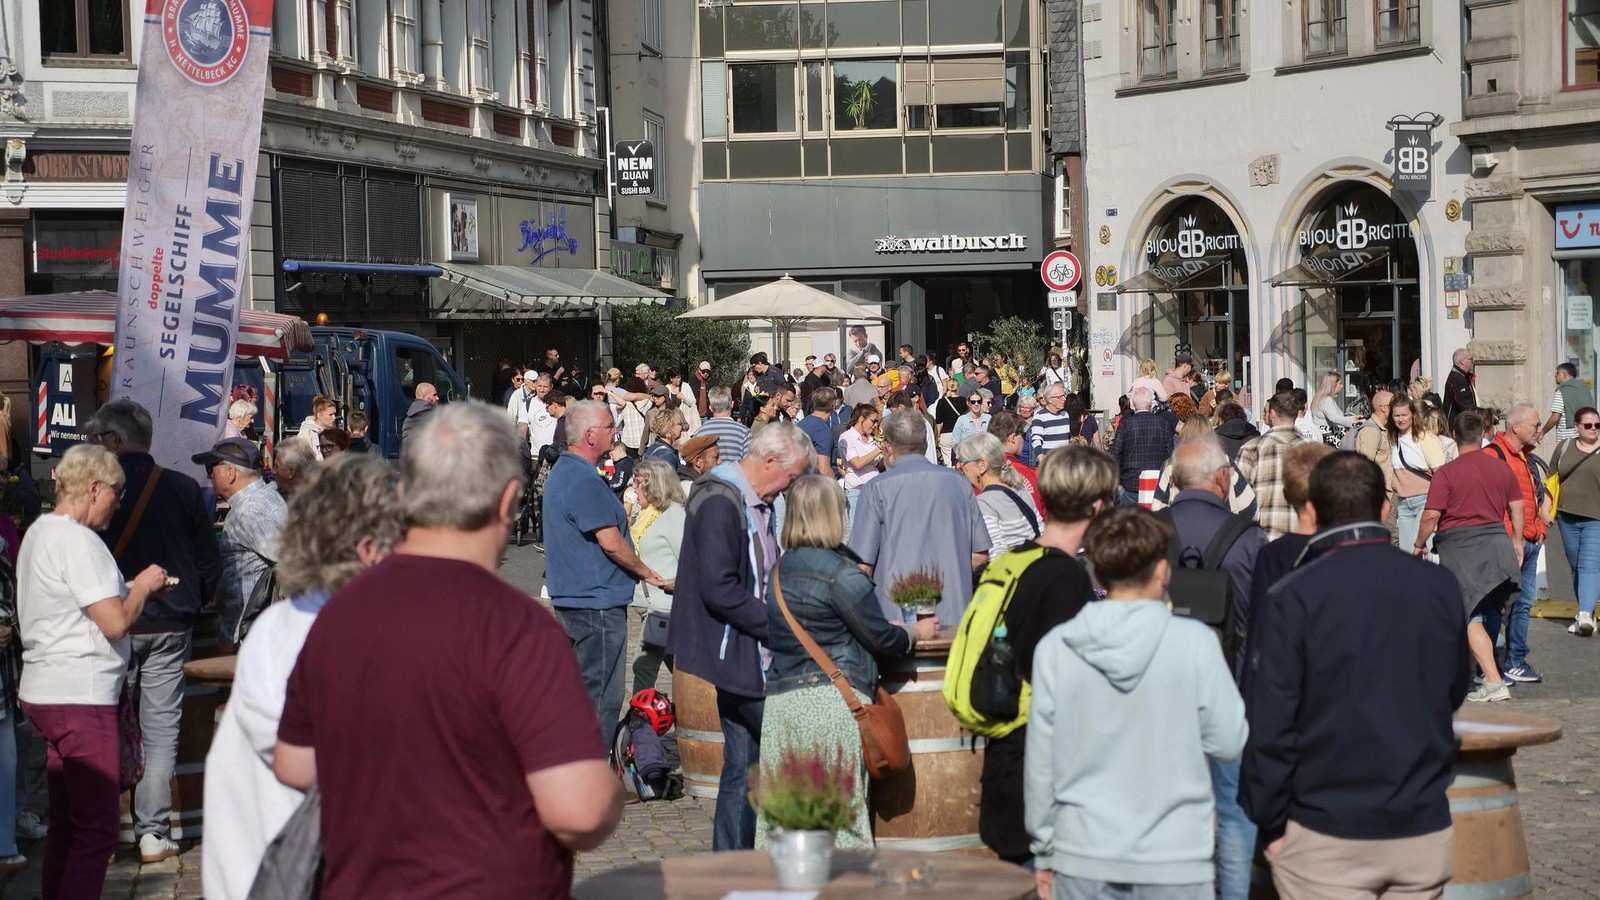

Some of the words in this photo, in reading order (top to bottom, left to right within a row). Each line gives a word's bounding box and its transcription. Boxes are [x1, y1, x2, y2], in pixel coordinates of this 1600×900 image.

[176, 53, 227, 80] NETTELBECK
[226, 55, 238, 70] KG
[617, 157, 652, 170] NEM
[622, 171, 649, 180] QUAN
[621, 187, 638, 195] SUSHI
[638, 186, 651, 194] BAR
[909, 233, 1027, 250] walbusch
[1146, 238, 1177, 257] BIJOU
[1300, 228, 1335, 249] BIJOU
[147, 247, 164, 310] doppelte
[159, 204, 192, 360] SEGELSCHIFF
[179, 151, 245, 429] MUMME
[62, 369, 72, 387] A
[51, 430, 60, 438] Wir
[60, 433, 81, 441] nennen
